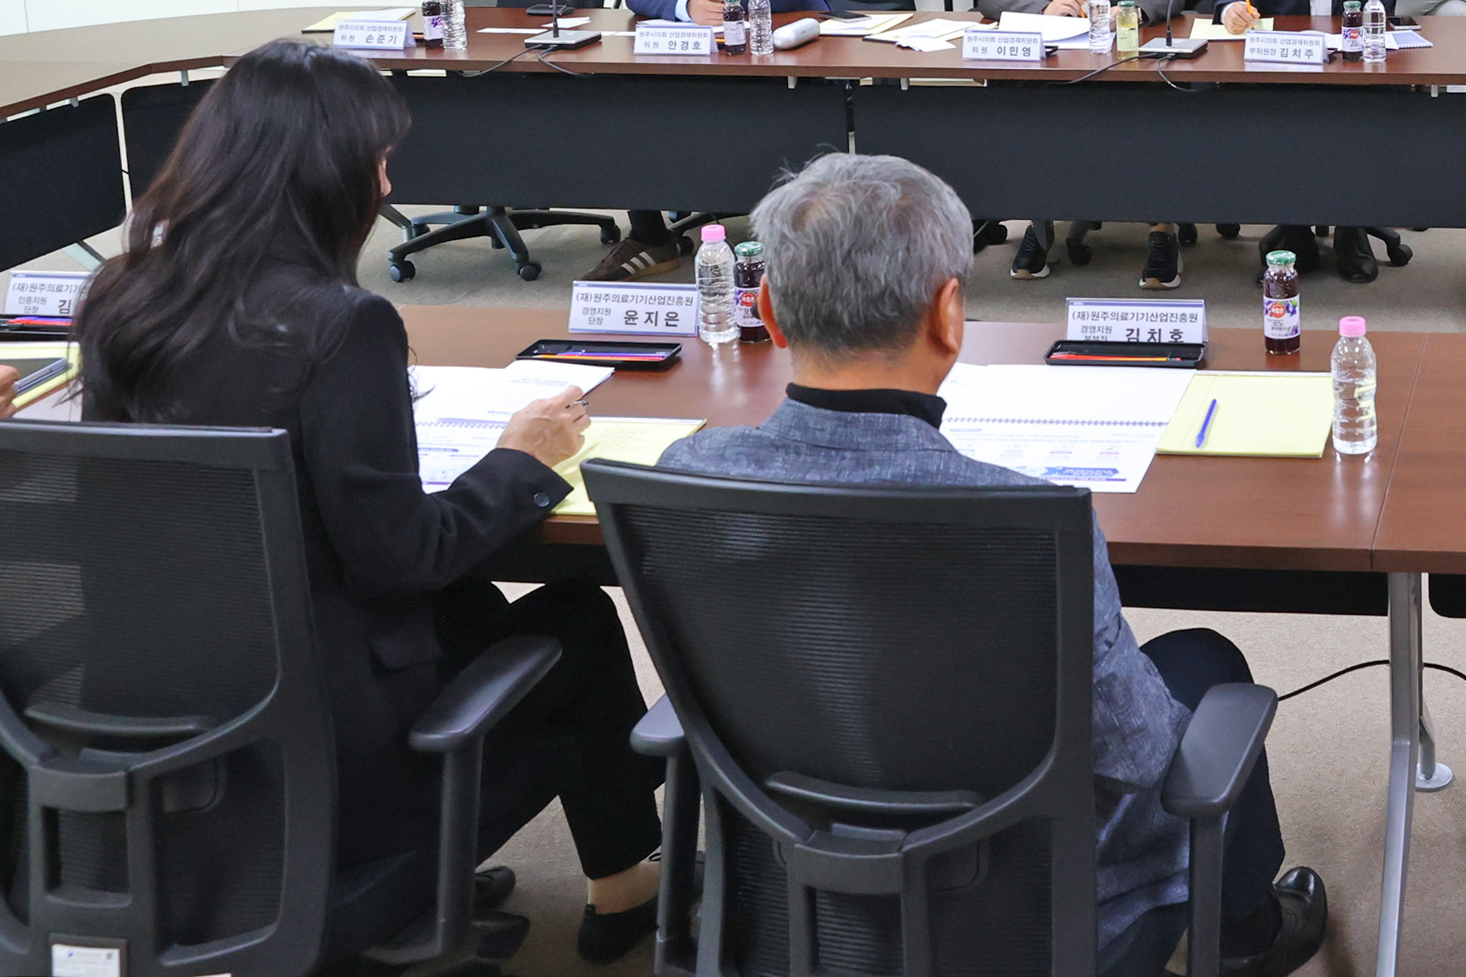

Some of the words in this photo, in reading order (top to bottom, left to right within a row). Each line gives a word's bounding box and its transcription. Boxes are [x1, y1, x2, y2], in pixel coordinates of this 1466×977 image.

[18, 296, 47, 305] 인증지원
[576, 292, 694, 307] (재)원주의료기기산업진흥원
[24, 306, 39, 314] 단장
[582, 307, 612, 316] 경영지원
[623, 309, 680, 327] 윤지은
[588, 316, 603, 325] 단장
[1072, 310, 1198, 323] (재)원주의료기기산업진흥원
[1080, 325, 1113, 334] 경영지원
